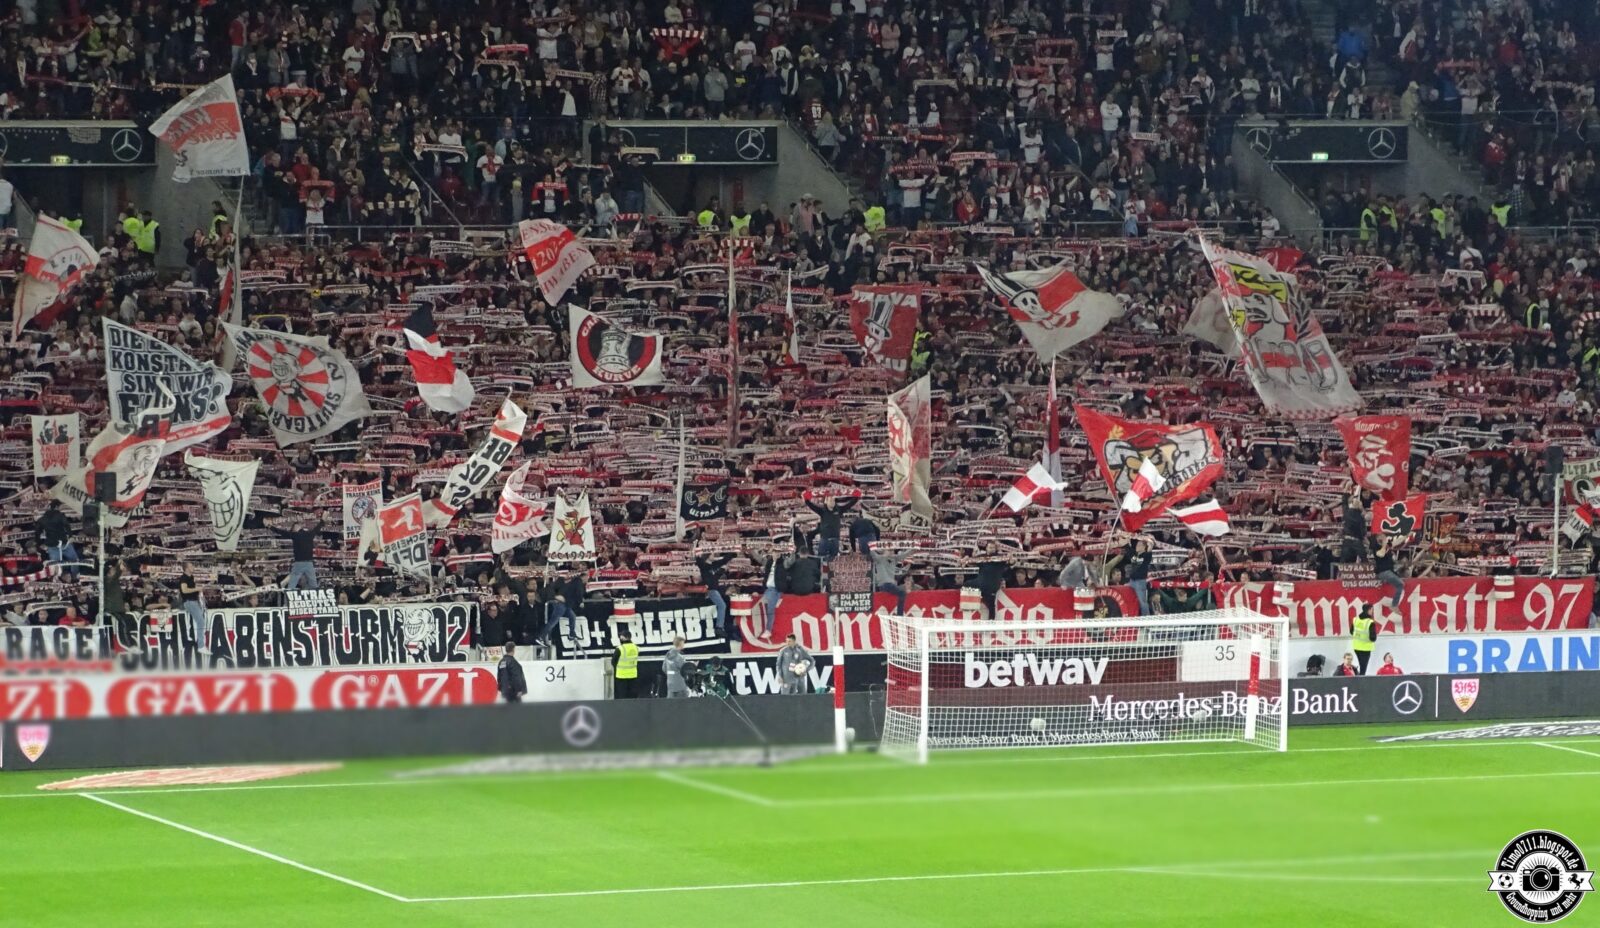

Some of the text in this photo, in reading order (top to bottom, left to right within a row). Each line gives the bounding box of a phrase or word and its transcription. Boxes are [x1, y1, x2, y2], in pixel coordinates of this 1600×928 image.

[109, 327, 143, 349] DIE
[592, 364, 642, 382] KURVE
[287, 588, 336, 600] ULTRAS
[289, 599, 338, 608] BEDEUTET
[289, 607, 340, 616] WIDERSTAND
[1523, 582, 1585, 631] 97
[627, 605, 718, 645] BLEIBT
[1214, 645, 1236, 661] 35
[1448, 636, 1600, 674] BRAIN
[545, 666, 567, 682] 34
[964, 653, 1109, 687] betway
[1088, 687, 1359, 722] Mercedes-Benz Bank
[927, 733, 1040, 746] Mercedes-Benz Bank
[1050, 728, 1160, 743] Mercedes-Benz Bank
